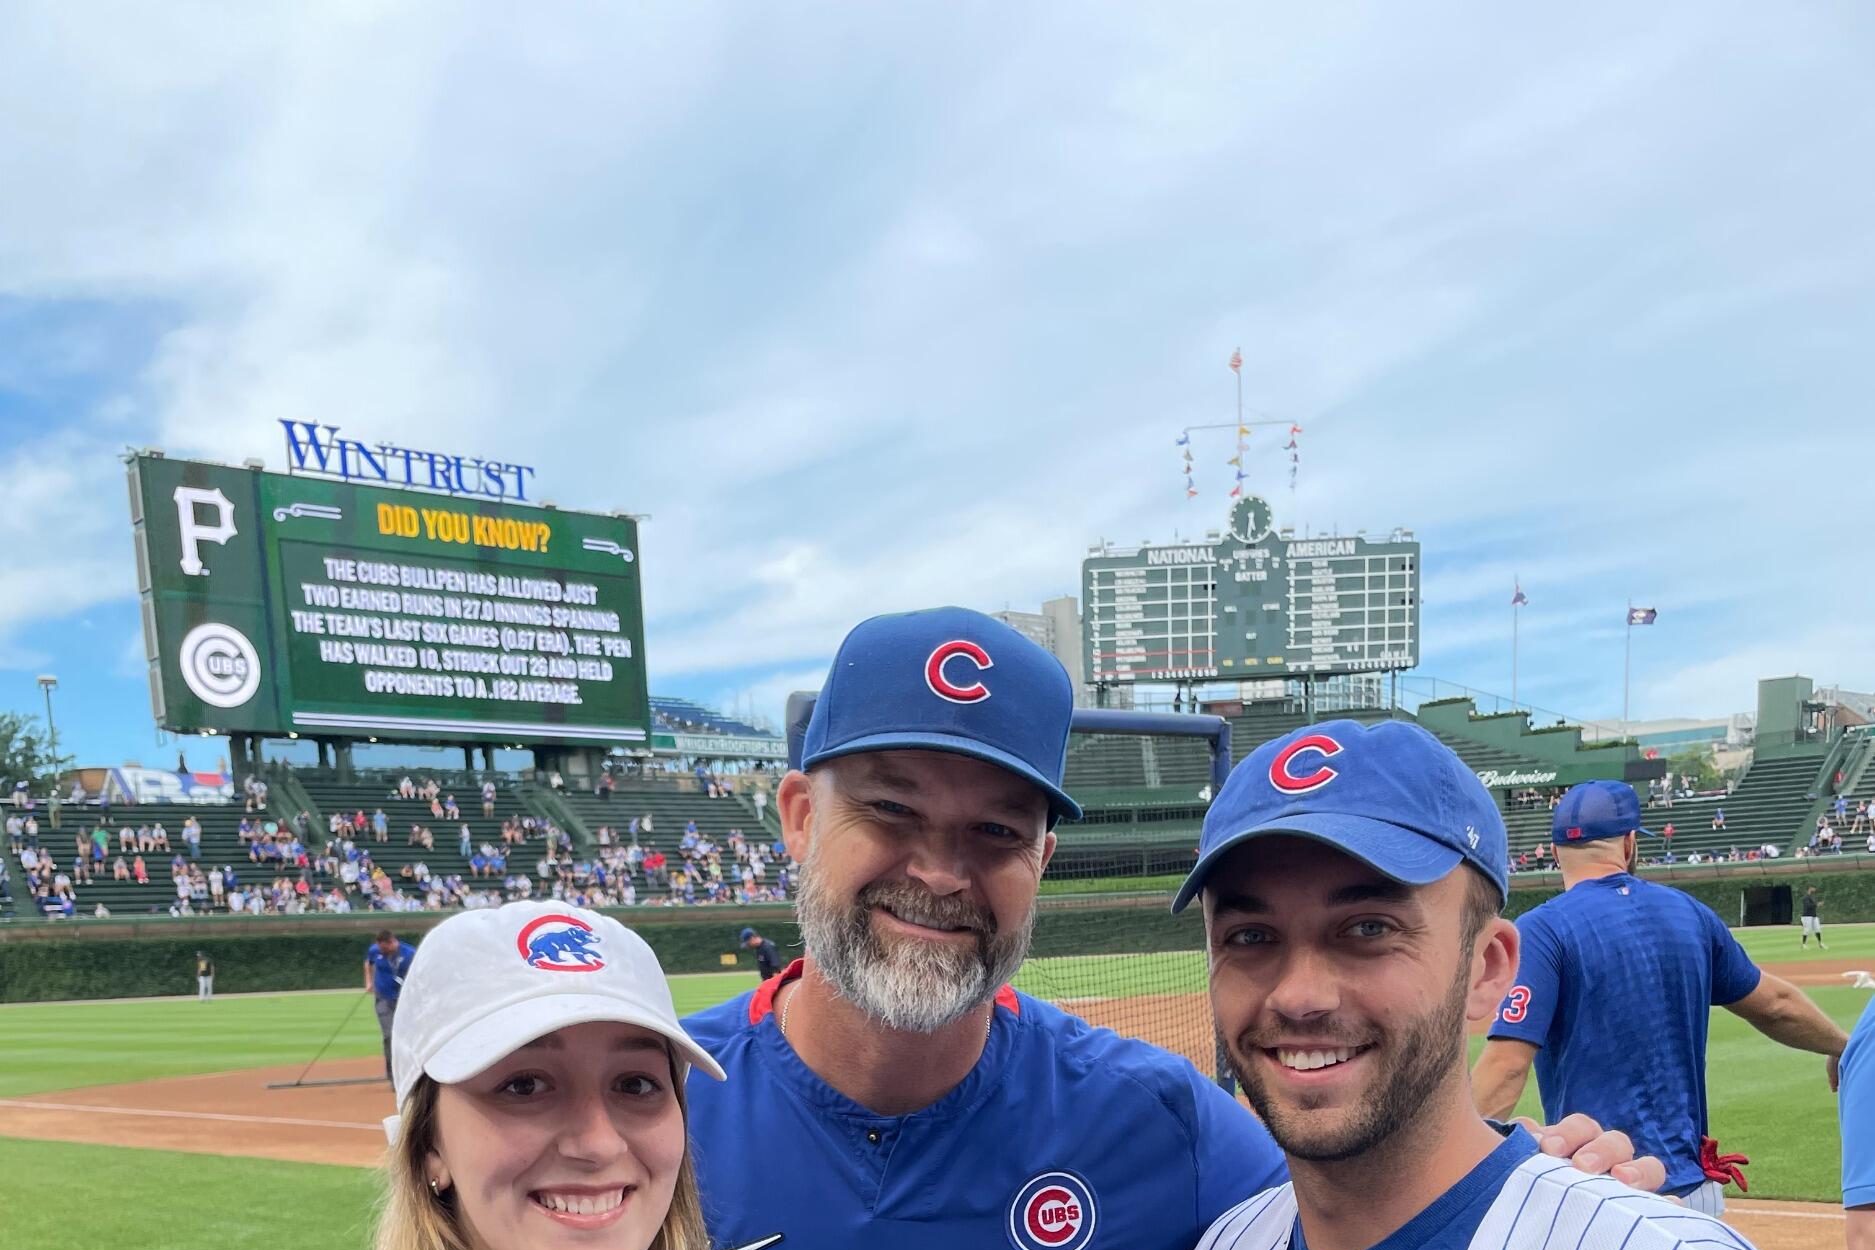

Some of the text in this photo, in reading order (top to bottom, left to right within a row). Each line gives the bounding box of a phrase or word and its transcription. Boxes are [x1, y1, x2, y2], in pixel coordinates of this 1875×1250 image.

[278, 417, 536, 501] WINTRUST
[377, 503, 551, 553] DID YOU KNOW?
[1286, 540, 1356, 558] AMERICAN
[1147, 547, 1217, 565] NATIONAL
[323, 557, 598, 605] THE CUBS BULLPEN HAS ALLOWED JUST
[301, 582, 620, 632] TWO EARNED RUNS IN 27.0 INNINGS SPANNING
[291, 610, 632, 658] THE TEAM'S LAST SIX GAMES (0.67 ERA). THE 'PEN
[320, 639, 613, 681] HAS WALKED 10, STRUCK OUT 26 AND HELD
[924, 639, 994, 704] C
[365, 670, 454, 697] OPPONENTS
[454, 675, 475, 698] TO
[475, 677, 487, 698] A
[518, 681, 583, 704] AVERAGE.
[1268, 734, 1344, 795] C
[1476, 769, 1557, 788] Budweiser
[1027, 1188, 1080, 1244] CUBS
